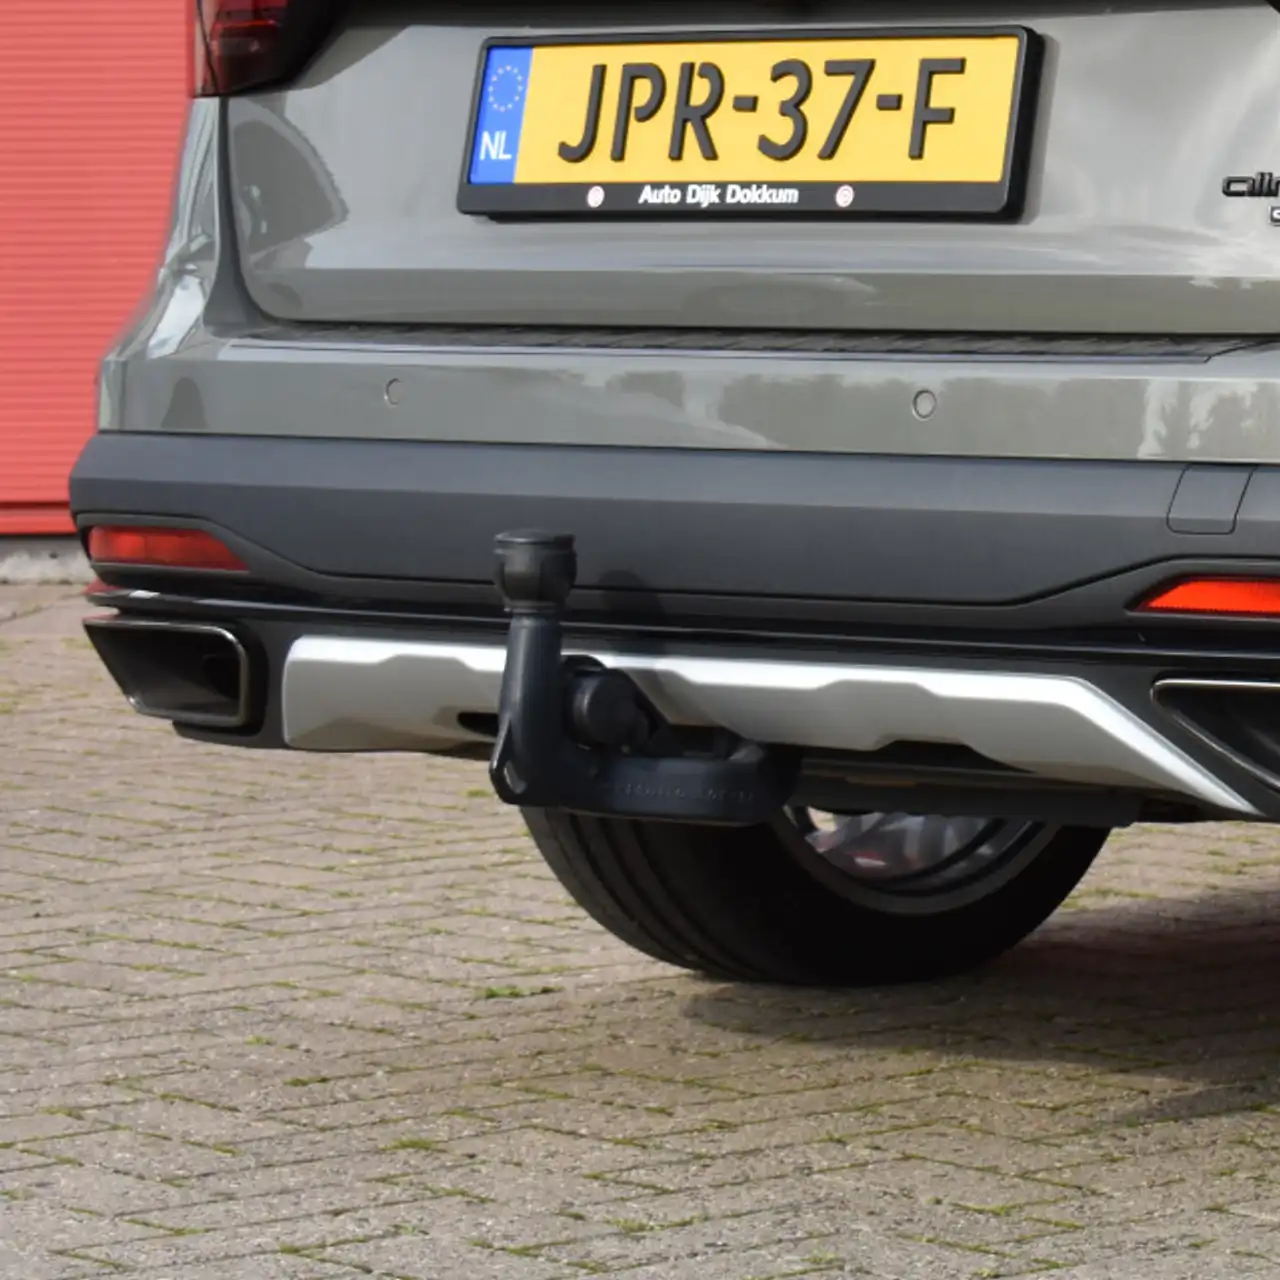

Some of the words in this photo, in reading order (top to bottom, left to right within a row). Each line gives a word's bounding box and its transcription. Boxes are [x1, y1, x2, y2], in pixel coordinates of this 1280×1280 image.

[557, 57, 966, 163] JPR-37-F
[480, 131, 512, 160] NL
[638, 184, 681, 204] Auto
[686, 184, 721, 208] Dijk
[726, 184, 799, 204] Dokkum
